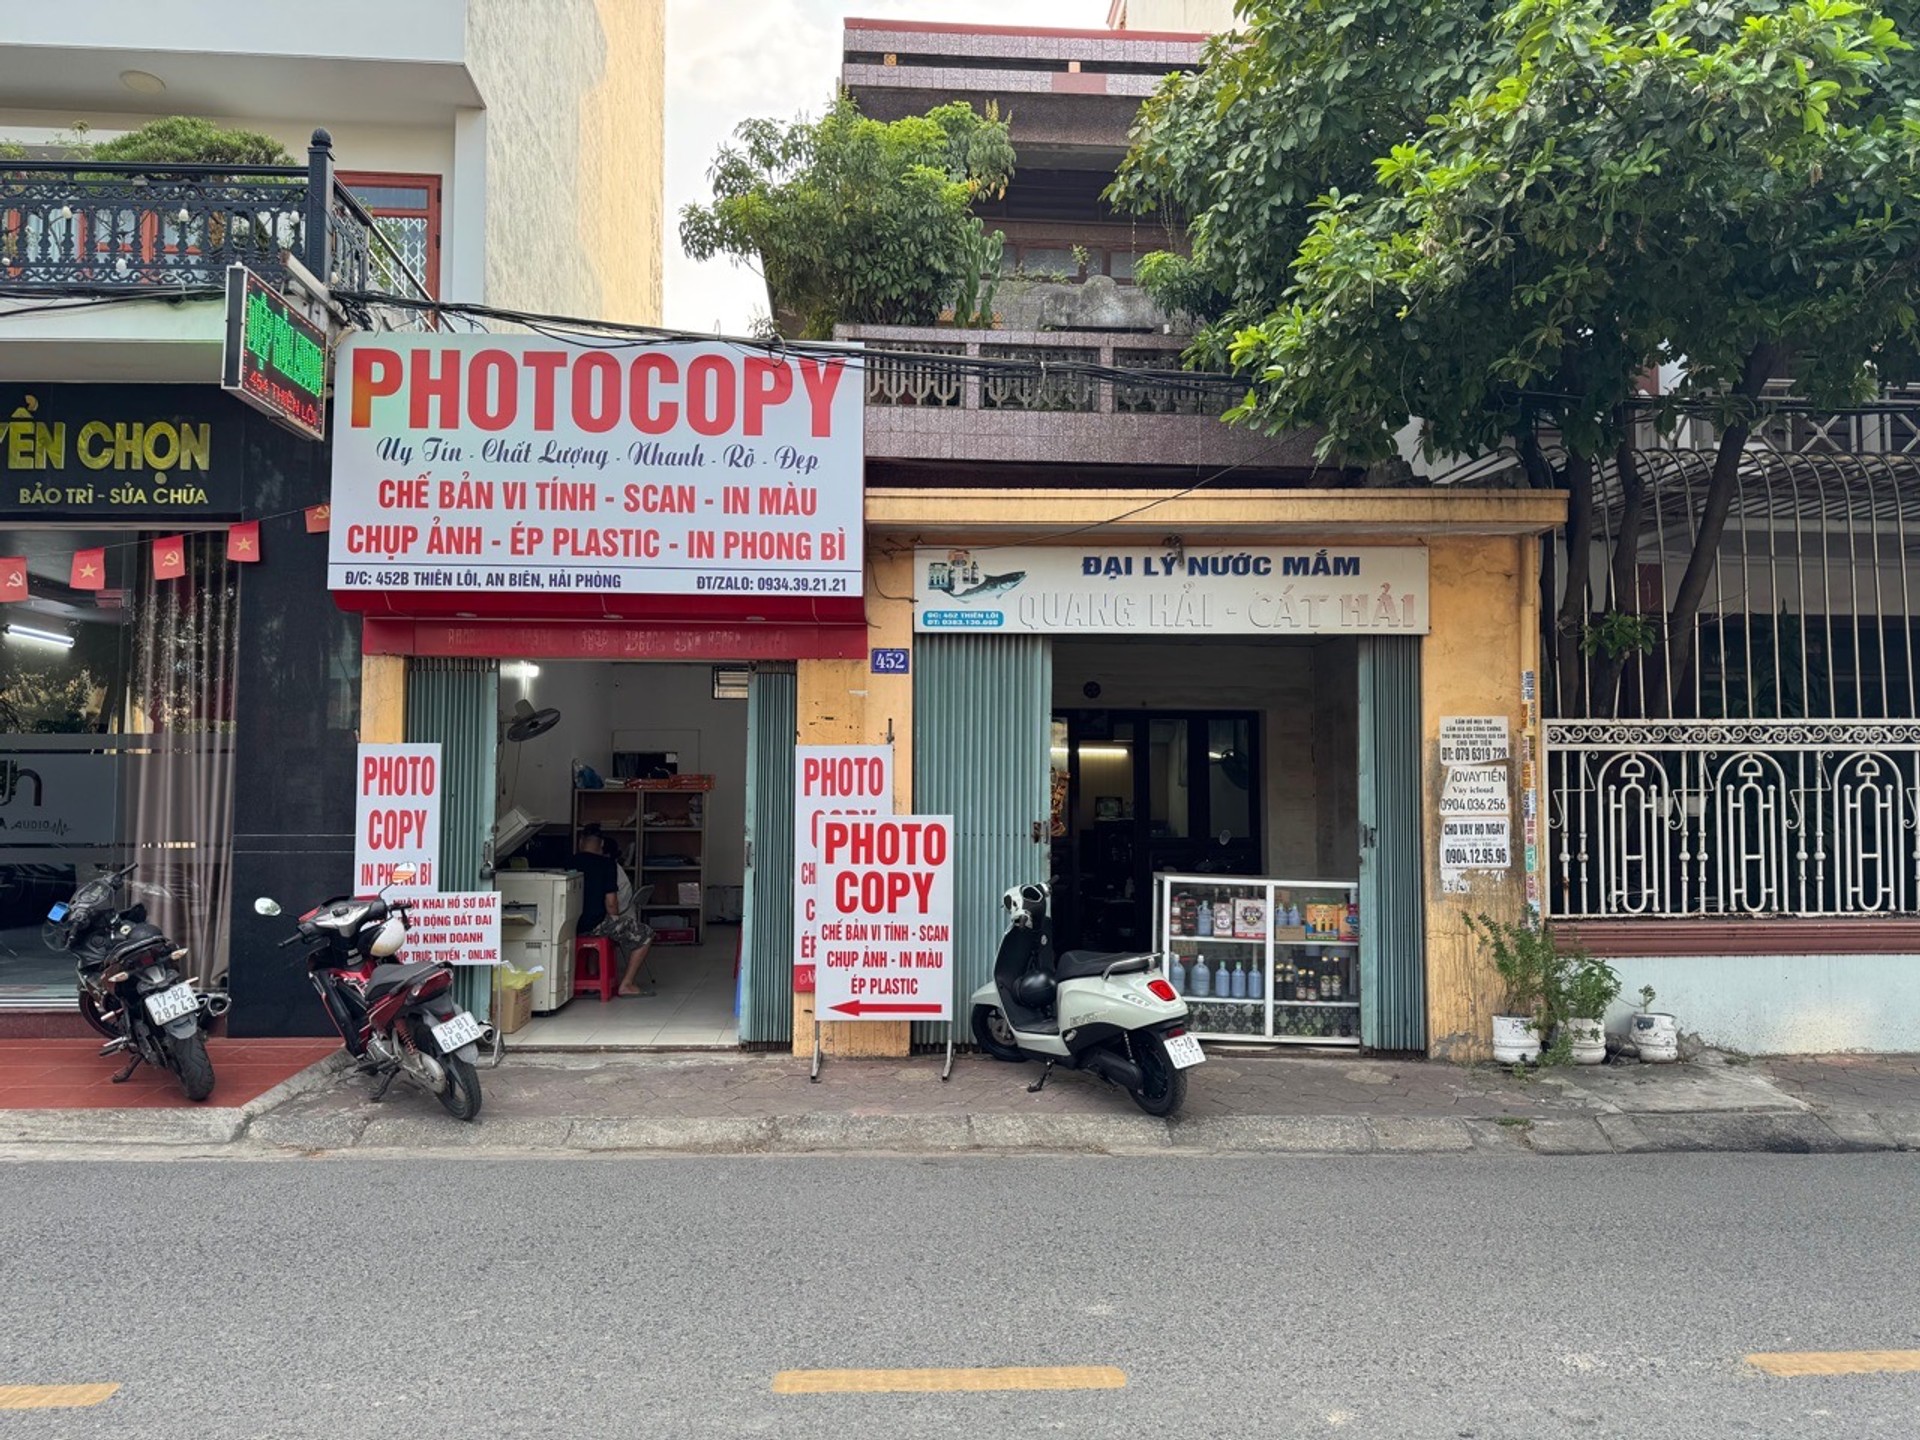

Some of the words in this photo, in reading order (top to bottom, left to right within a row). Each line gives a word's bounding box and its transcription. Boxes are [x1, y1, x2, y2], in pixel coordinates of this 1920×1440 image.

[351, 347, 847, 437] PHOTOCOPY
[77, 421, 211, 484] CHỌN
[377, 437, 414, 466] Uy
[421, 437, 463, 463] Tín
[481, 438, 533, 464] Chất
[537, 440, 610, 470] Lượng
[628, 441, 706, 467] Nhanh
[723, 444, 756, 468] Rõ
[774, 445, 820, 475] Đẹp
[19, 482, 62, 504] BẢO
[66, 483, 94, 504] TRÌ
[110, 482, 147, 504] SỬA
[153, 483, 208, 504] CHỮA
[378, 471, 432, 509] CHẾ
[439, 471, 494, 510] BẢN
[502, 481, 527, 510] VI
[535, 476, 596, 511] TÍNH
[623, 483, 696, 513] SCAN
[723, 486, 750, 514] IN
[758, 481, 817, 516] MÀU
[346, 524, 418, 561] CHỤP
[426, 516, 482, 555] ẢNH
[510, 521, 544, 556] ÉP
[552, 527, 660, 558] PLASTIC
[688, 530, 714, 559] IN
[723, 531, 811, 561] PHONG
[820, 527, 845, 561] BÌ
[1082, 556, 1133, 581] ĐẠI
[1144, 553, 1175, 577] LÝ
[1187, 552, 1272, 577] NƯỚC
[1282, 549, 1360, 577] MẮM
[345, 571, 372, 587] Đ/C:
[375, 571, 409, 587] 452B
[414, 570, 452, 587] THIÊN
[456, 571, 481, 589] LÔI,
[485, 572, 504, 588] AN
[509, 570, 544, 590] BIÊN,
[549, 571, 571, 589] HẢI
[575, 571, 621, 590] PHÒNG
[696, 576, 753, 592] ĐT/ZALO:
[757, 577, 846, 593] 0934.39.21.21
[1018, 593, 1136, 630] QUANG
[1149, 581, 1214, 628] HẢI
[1248, 584, 1330, 629] CÁT
[1339, 582, 1416, 628] HẢI
[875, 652, 906, 671] 452
[1455, 747, 1469, 761] 079
[1472, 747, 1490, 761] 6319
[363, 756, 435, 796] PHOTO
[803, 757, 884, 796] PHOTO
[368, 810, 428, 850] COPY
[1459, 824, 1473, 835] VAY
[825, 822, 947, 866] PHOTO
[1445, 848, 1507, 863] 0904.12.95.96
[361, 863, 373, 886] IN
[420, 858, 432, 886] BÌ
[422, 898, 445, 909] KHAI
[835, 871, 935, 914] COPY
[423, 914, 451, 929] ĐỘNG
[454, 911, 473, 926] ĐẤT
[475, 914, 492, 925] ĐAI
[821, 919, 843, 941] CHẾ
[846, 918, 868, 941] BẢN
[871, 924, 881, 941] VI
[884, 921, 909, 941] TÍNH
[919, 925, 949, 942] SCAN
[406, 931, 420, 946] HỘ
[423, 933, 447, 944] KINH
[450, 932, 483, 944] DOANH
[468, 948, 497, 960] ONLINE
[826, 950, 859, 972] CHỤP
[862, 945, 887, 968] ẢNH
[899, 951, 912, 968] IN
[915, 948, 943, 969] MÀU
[153, 986, 188, 1008] 17-B2
[850, 974, 866, 994] ÉP
[870, 977, 918, 995] PLASTIC
[154, 996, 197, 1022] 282.43
[439, 1016, 470, 1037] 15-B1
[441, 1024, 480, 1050] 648.15
